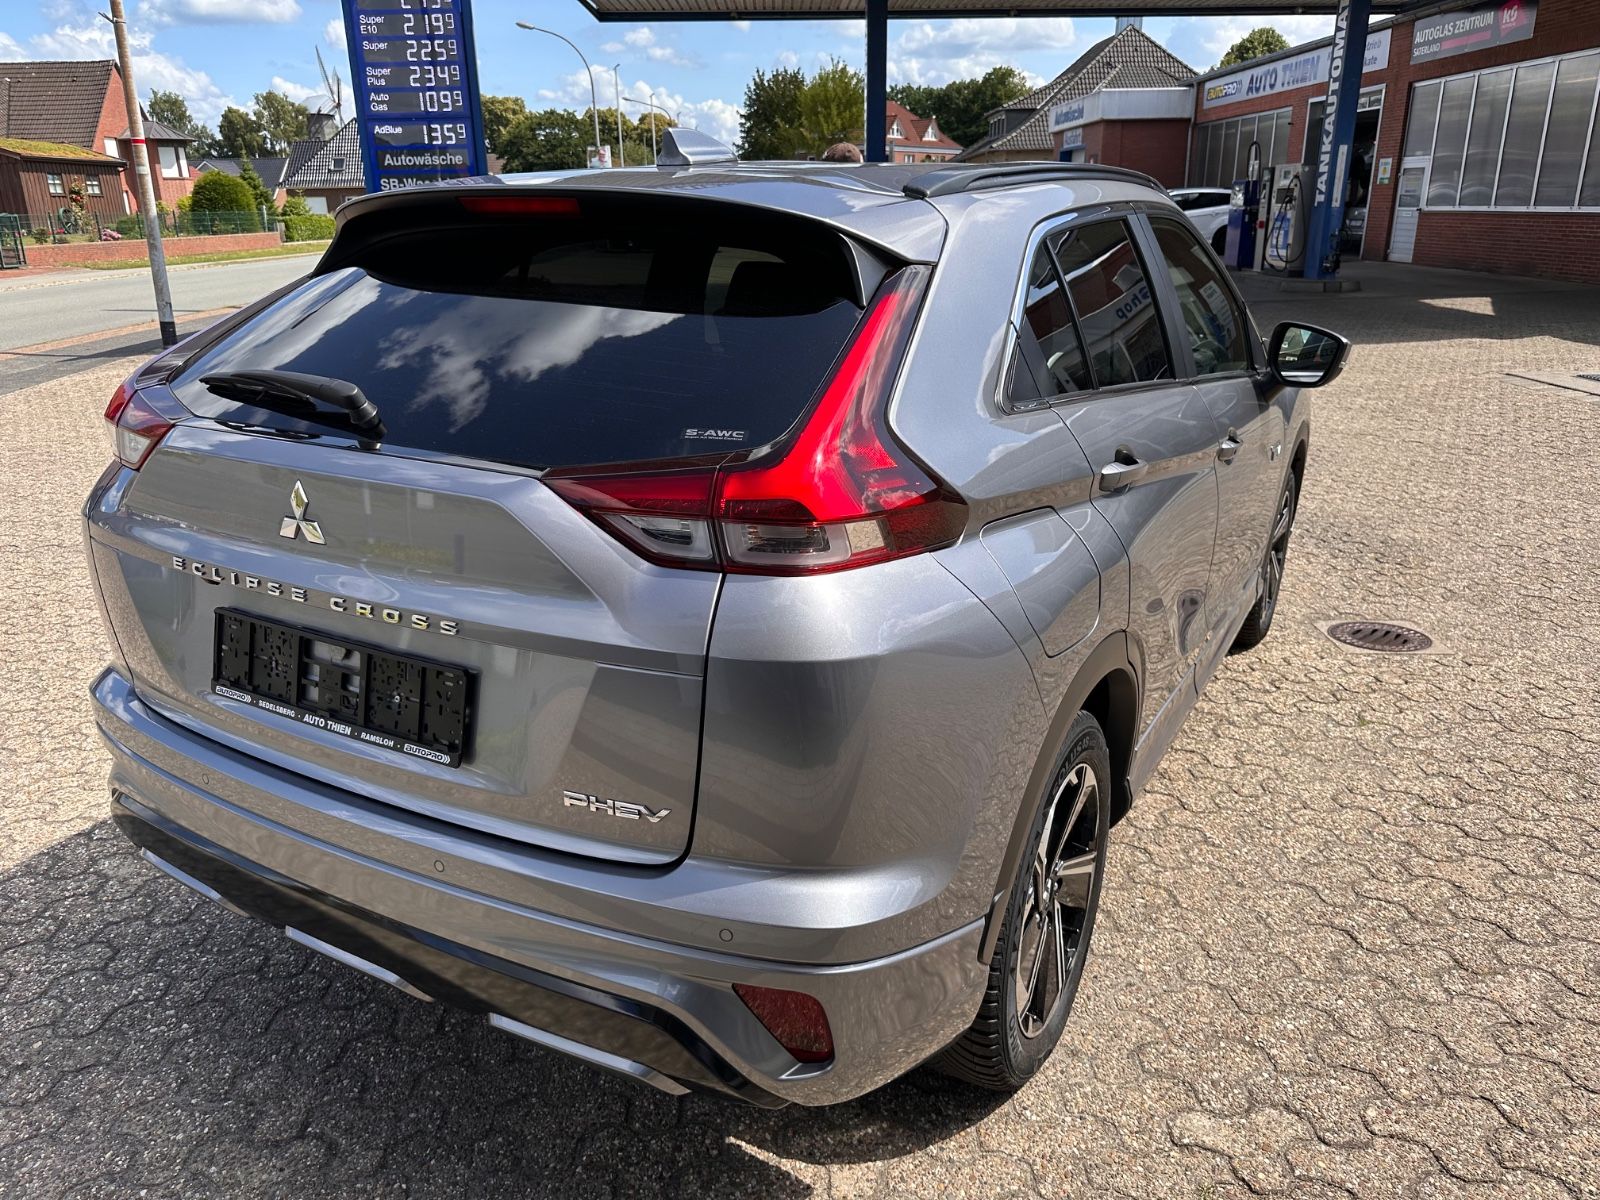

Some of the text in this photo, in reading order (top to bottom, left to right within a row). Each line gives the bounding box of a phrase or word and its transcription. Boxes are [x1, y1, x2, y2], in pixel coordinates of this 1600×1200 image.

[359, 15, 384, 26] Super
[360, 26, 378, 34] E10
[1414, 11, 1495, 44] AUTOGLAS ZENTRUM
[363, 41, 388, 51] Super
[1413, 43, 1440, 57] SATERLAND
[366, 67, 391, 77] Super
[1246, 67, 1277, 96] AUTO
[1282, 55, 1320, 88] THIEN
[367, 77, 386, 86] Plus
[370, 93, 389, 101] Auto
[371, 103, 388, 111] Gas
[374, 125, 403, 134] AdBlue
[384, 153, 463, 166] Autowäsche
[685, 428, 745, 438] S-AWC
[172, 556, 458, 636] ECLIPSE CROSS
[258, 700, 296, 718] SEDELSBERG
[303, 713, 325, 728] AUTO
[327, 719, 352, 736] THIEN
[360, 731, 394, 748] RAMSLOH
[563, 789, 672, 823] PHEV
